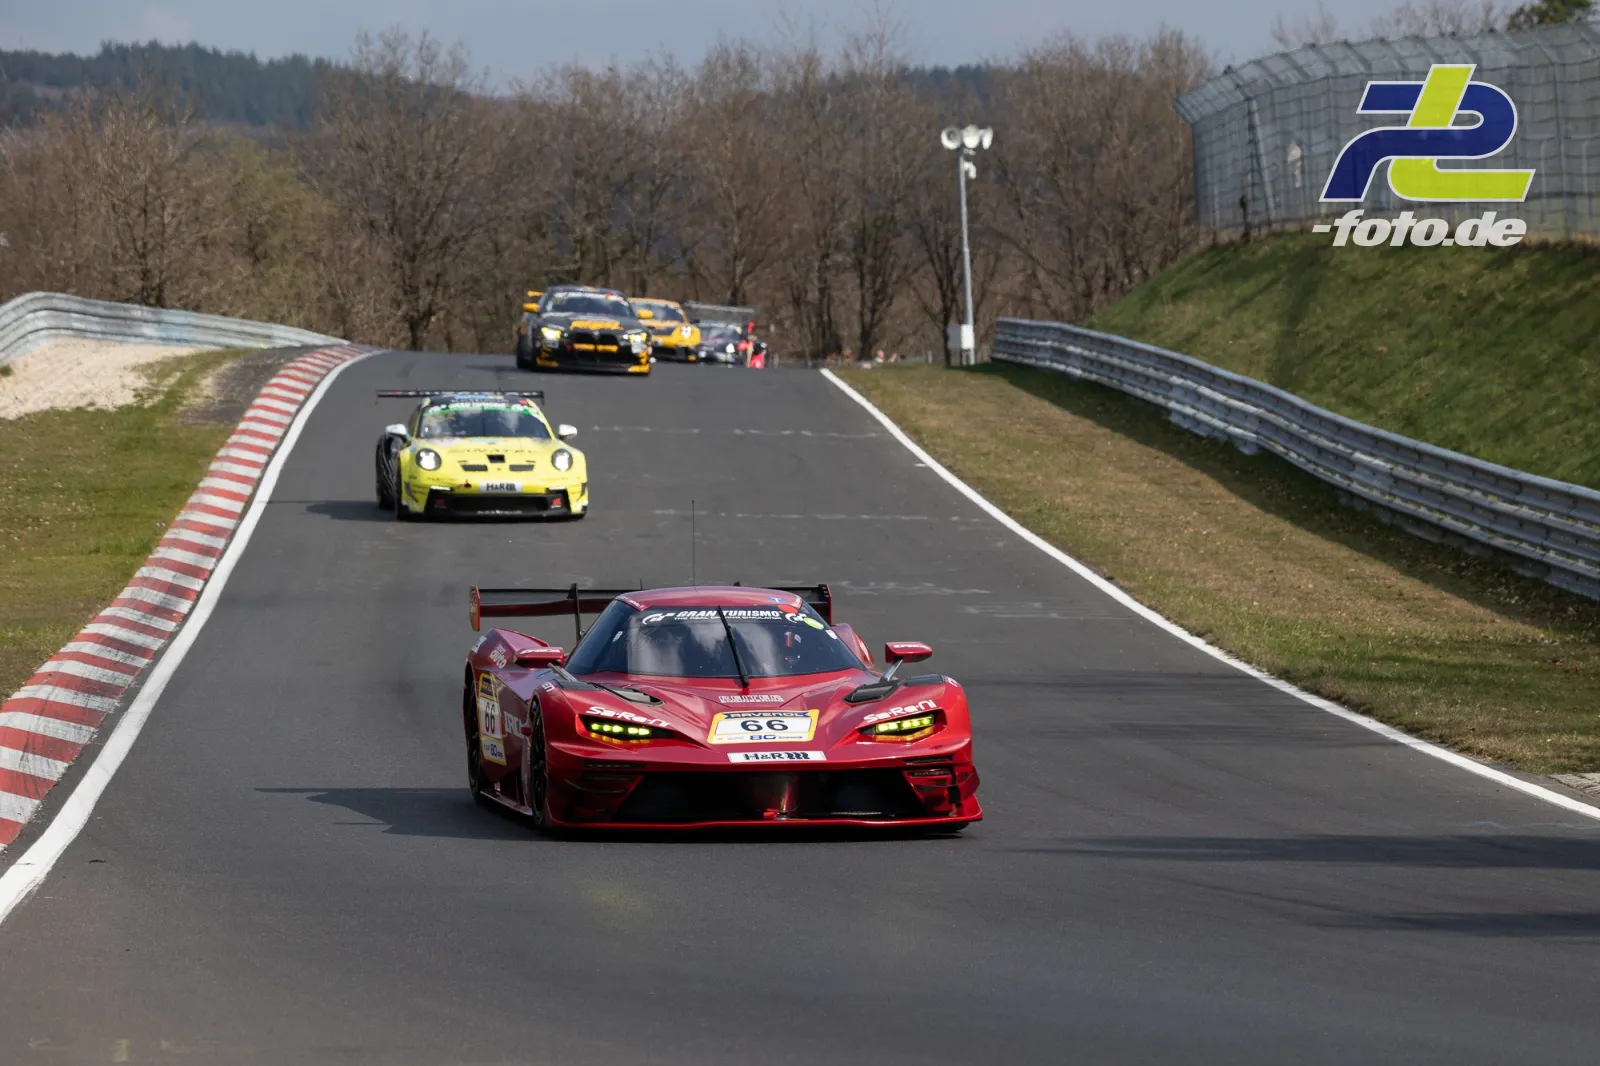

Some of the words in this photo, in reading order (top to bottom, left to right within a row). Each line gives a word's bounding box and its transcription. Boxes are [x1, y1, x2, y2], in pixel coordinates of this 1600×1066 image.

[676, 610, 718, 618] GRAN
[485, 702, 496, 735] 66
[740, 719, 788, 732] 66
[744, 752, 785, 760] H&R
